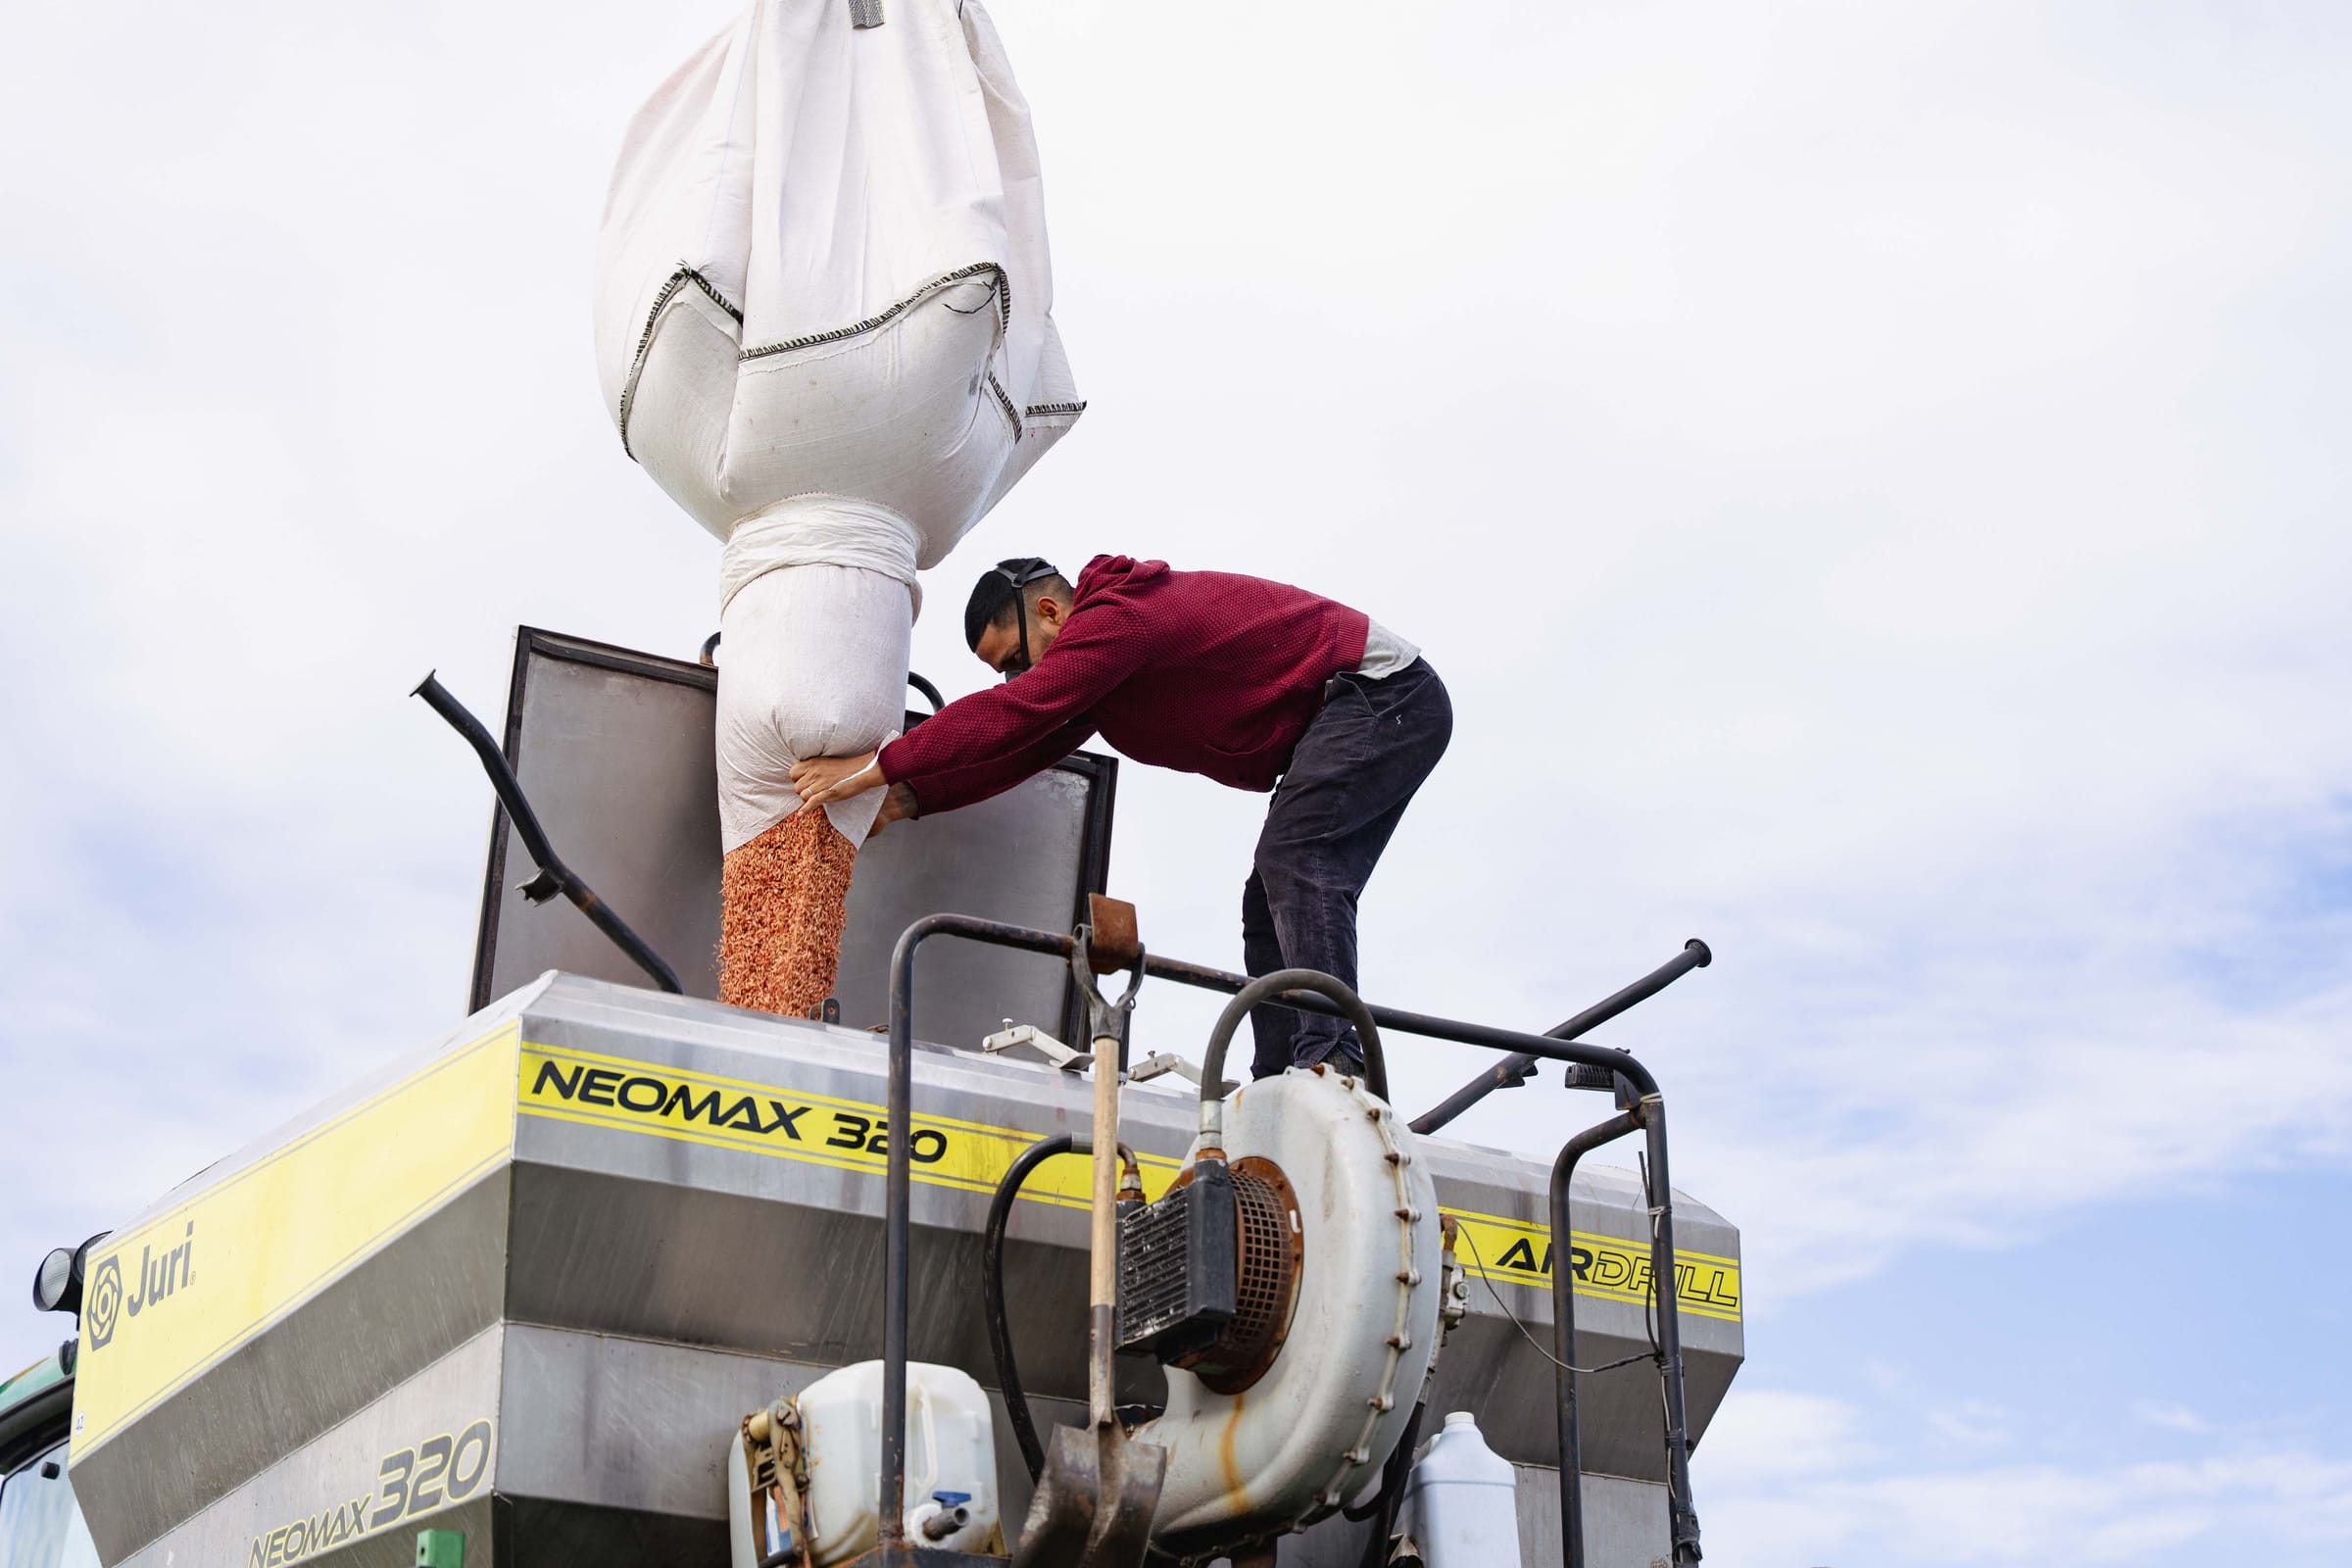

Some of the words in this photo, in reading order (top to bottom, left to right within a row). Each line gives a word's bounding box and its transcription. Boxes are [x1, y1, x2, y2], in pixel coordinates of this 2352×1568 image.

[531, 1060, 812, 1141] NEOMAX
[127, 1220, 194, 1318] Juri
[248, 1493, 373, 1568] NEOMAX
[368, 1417, 492, 1533] 320
